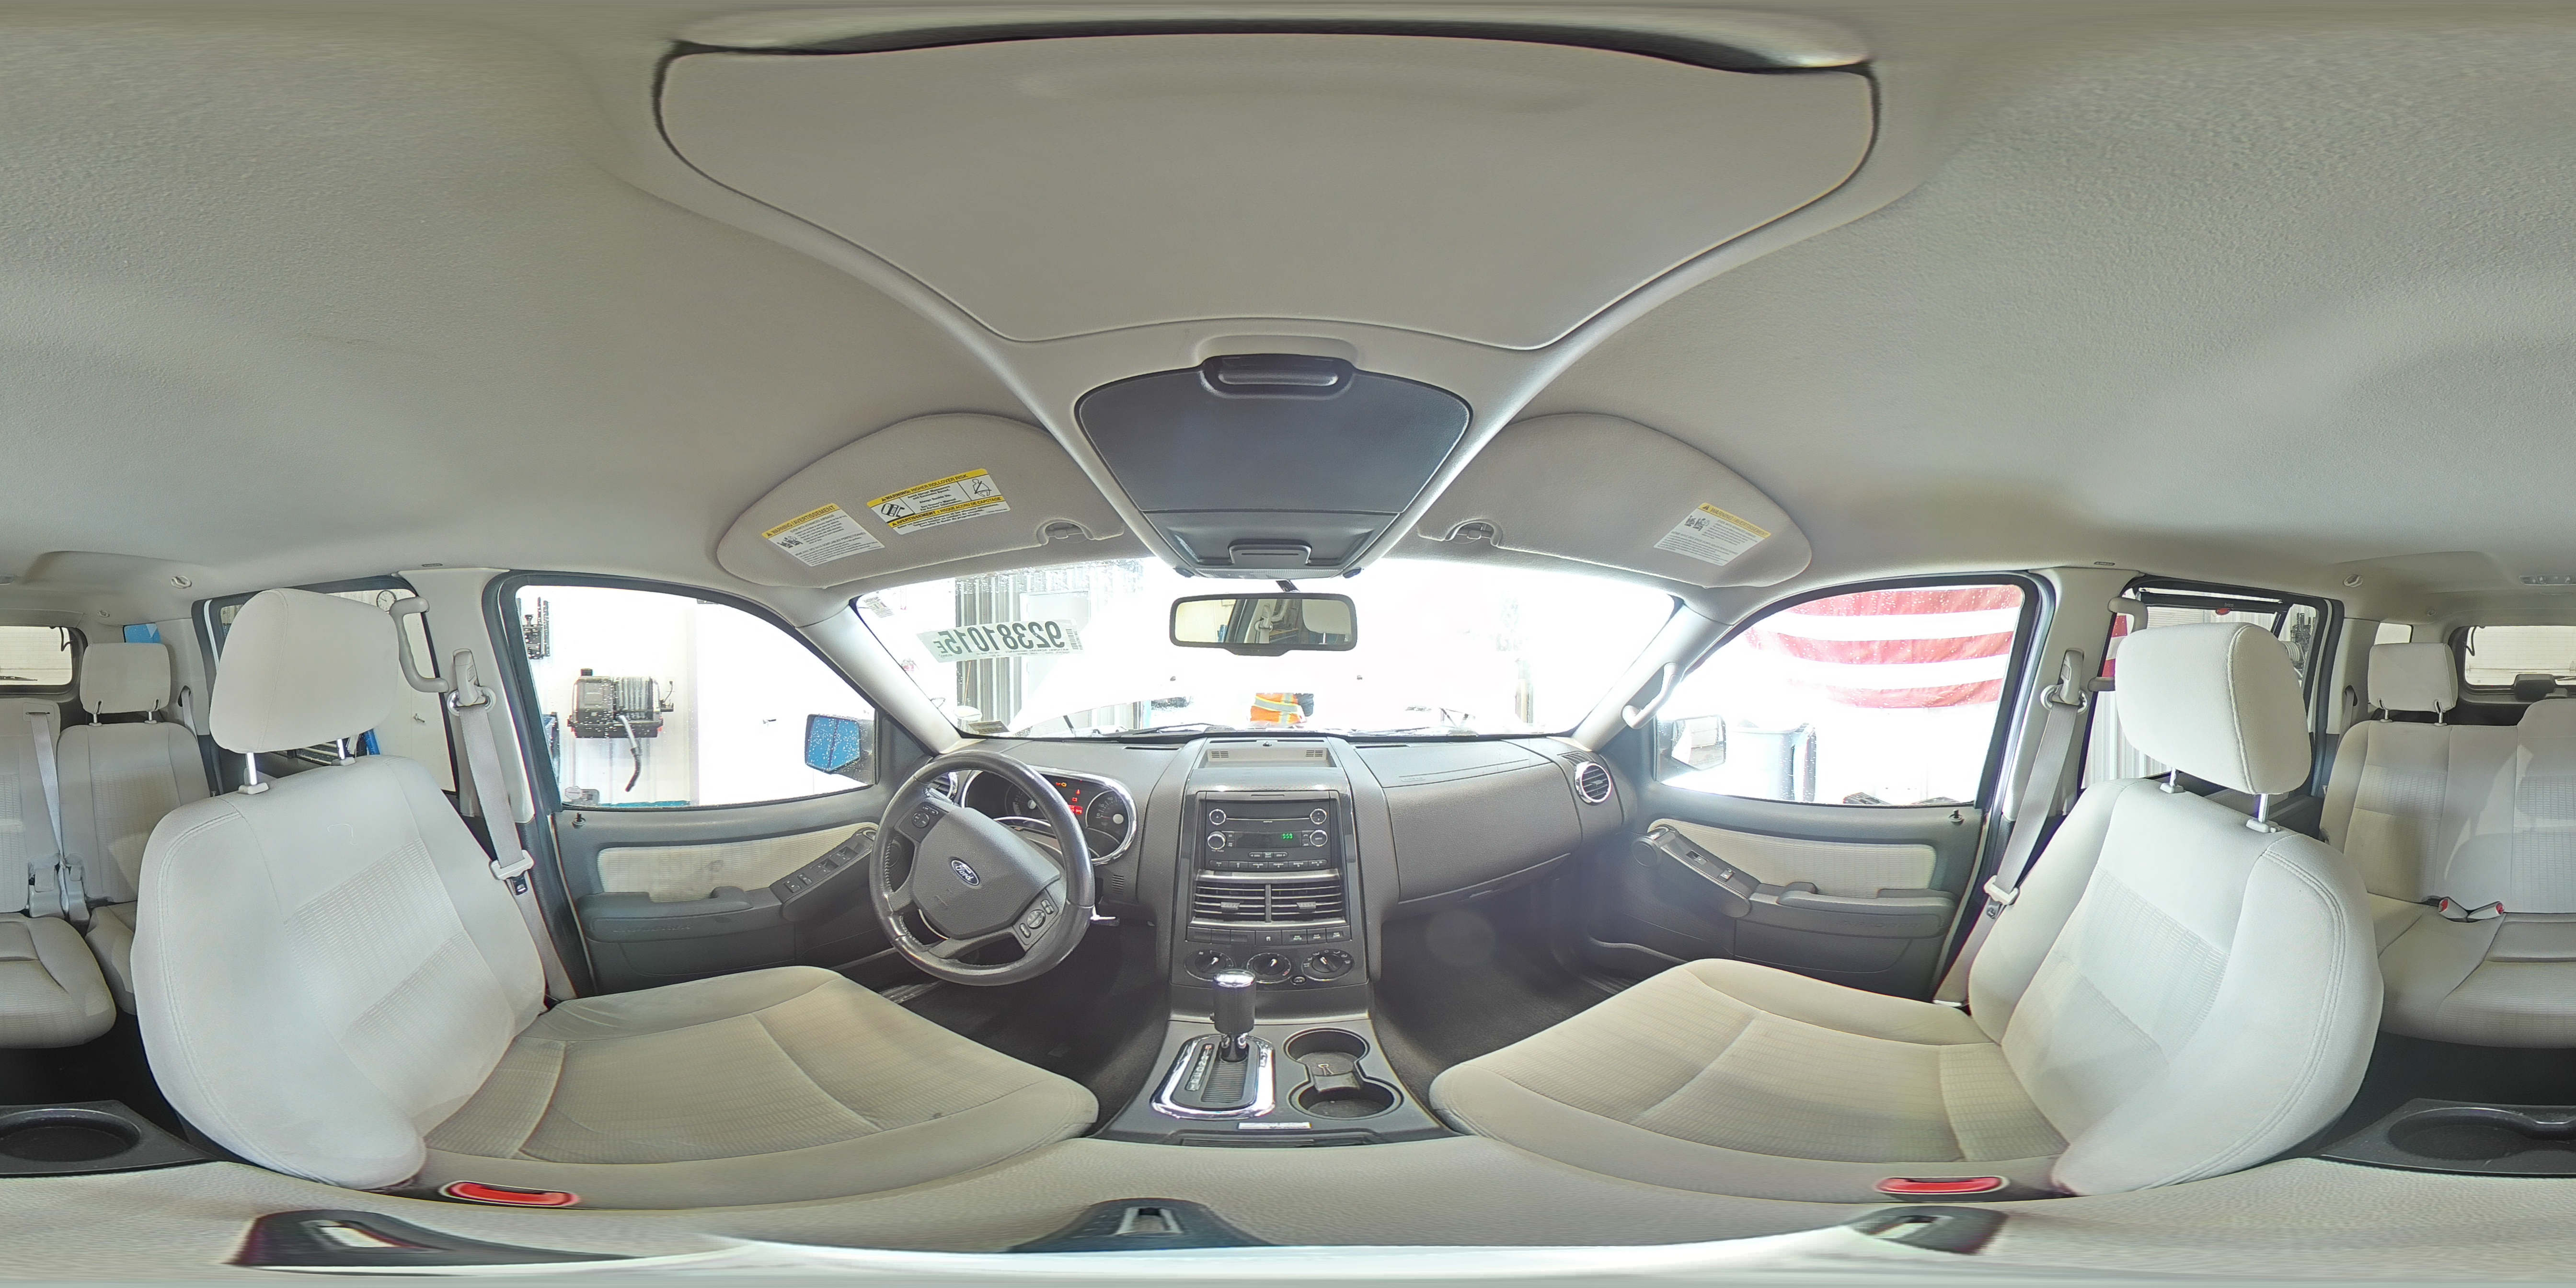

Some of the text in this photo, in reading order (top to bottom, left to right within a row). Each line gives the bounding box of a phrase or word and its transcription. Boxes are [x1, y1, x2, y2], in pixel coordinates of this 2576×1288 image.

[928, 477, 955, 487] ROLLOVER
[770, 523, 794, 534] WARNING
[792, 504, 836, 525] AVERTISSEMENT
[1709, 507, 1734, 520] WARNING
[1733, 518, 1769, 536] AVERTISSEMENT
[955, 864, 974, 881] Ford
